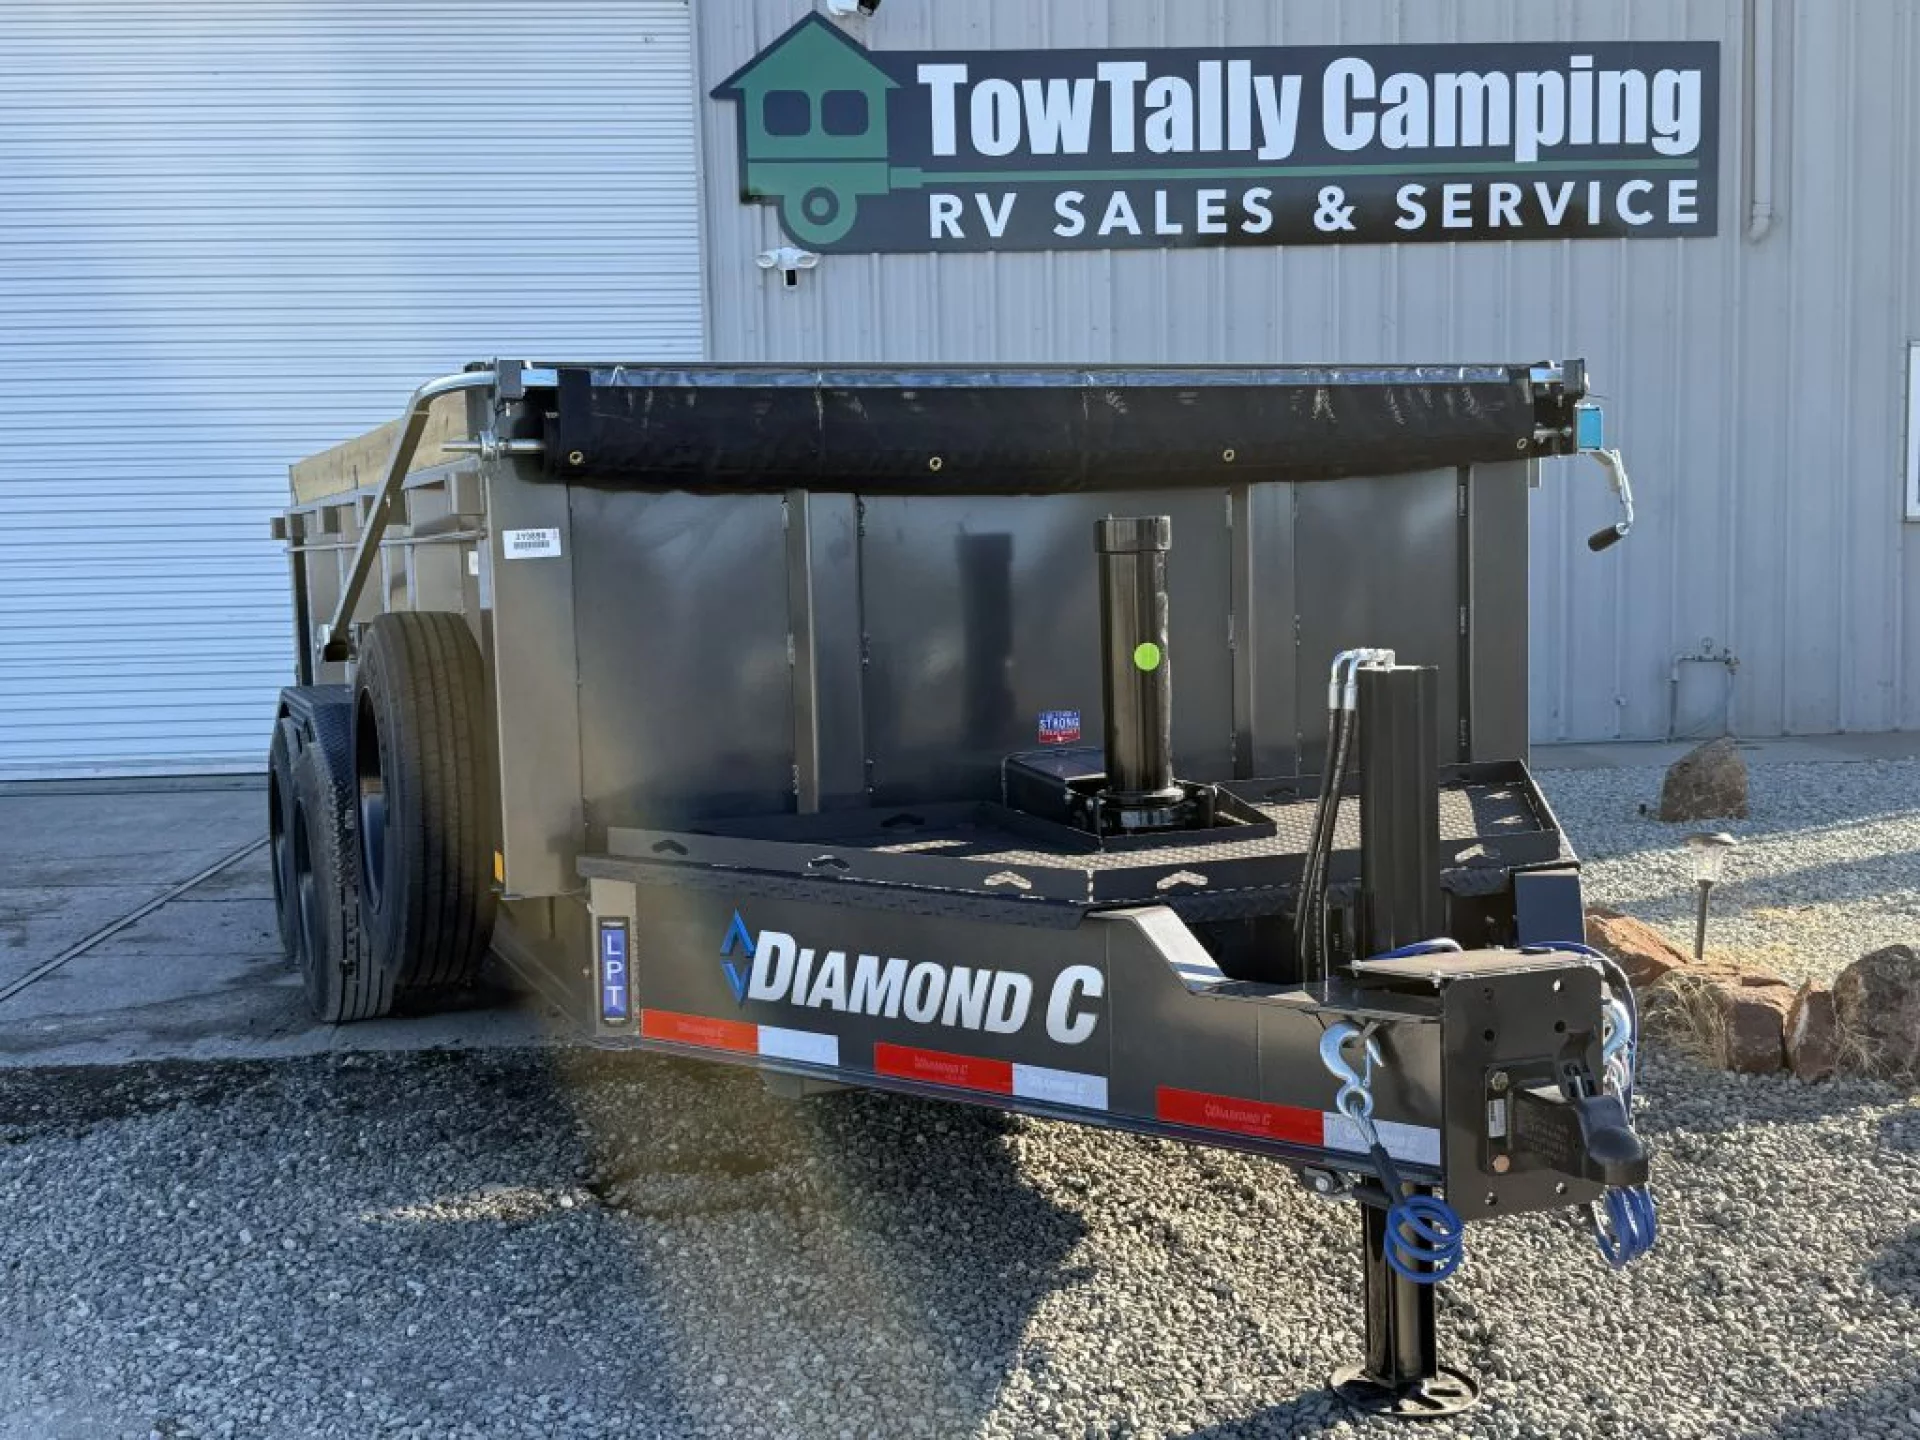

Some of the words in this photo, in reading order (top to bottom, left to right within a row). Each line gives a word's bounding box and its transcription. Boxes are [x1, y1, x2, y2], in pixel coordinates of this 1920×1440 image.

[917, 59, 1302, 161] TowTally
[1322, 54, 1702, 164] Camping
[929, 191, 1017, 240] RV
[1053, 186, 1275, 238] SALES
[1312, 184, 1357, 235] &
[1394, 179, 1699, 231] SERVICE
[606, 934, 624, 1006] LPT
[748, 929, 1034, 1035] DIAMOND
[1045, 965, 1105, 1045] C
